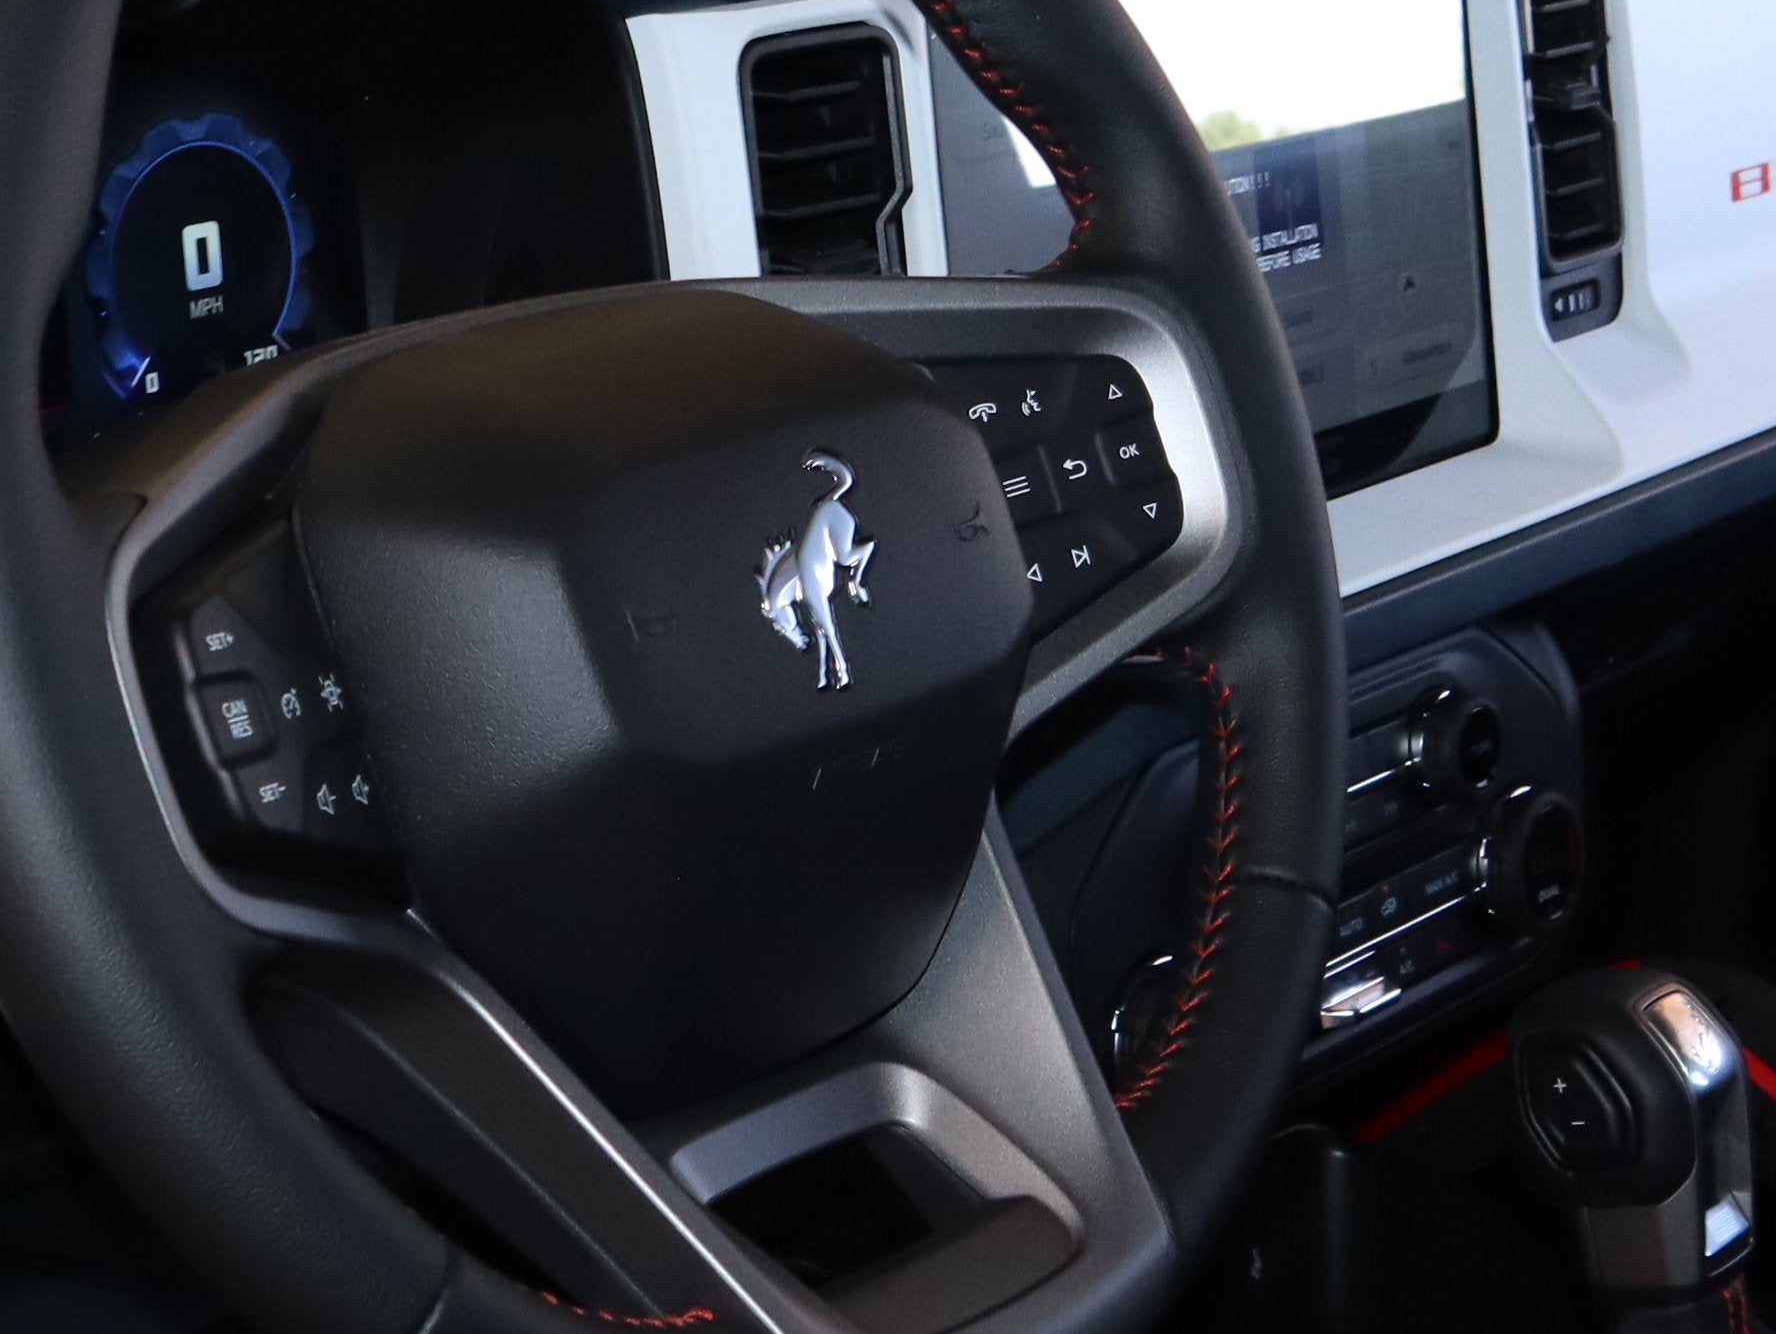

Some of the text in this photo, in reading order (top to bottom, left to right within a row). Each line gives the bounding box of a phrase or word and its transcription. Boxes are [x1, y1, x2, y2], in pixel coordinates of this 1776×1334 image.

[181, 220, 224, 292] 0
[189, 294, 224, 319] MPH
[1118, 442, 1140, 459] OK
